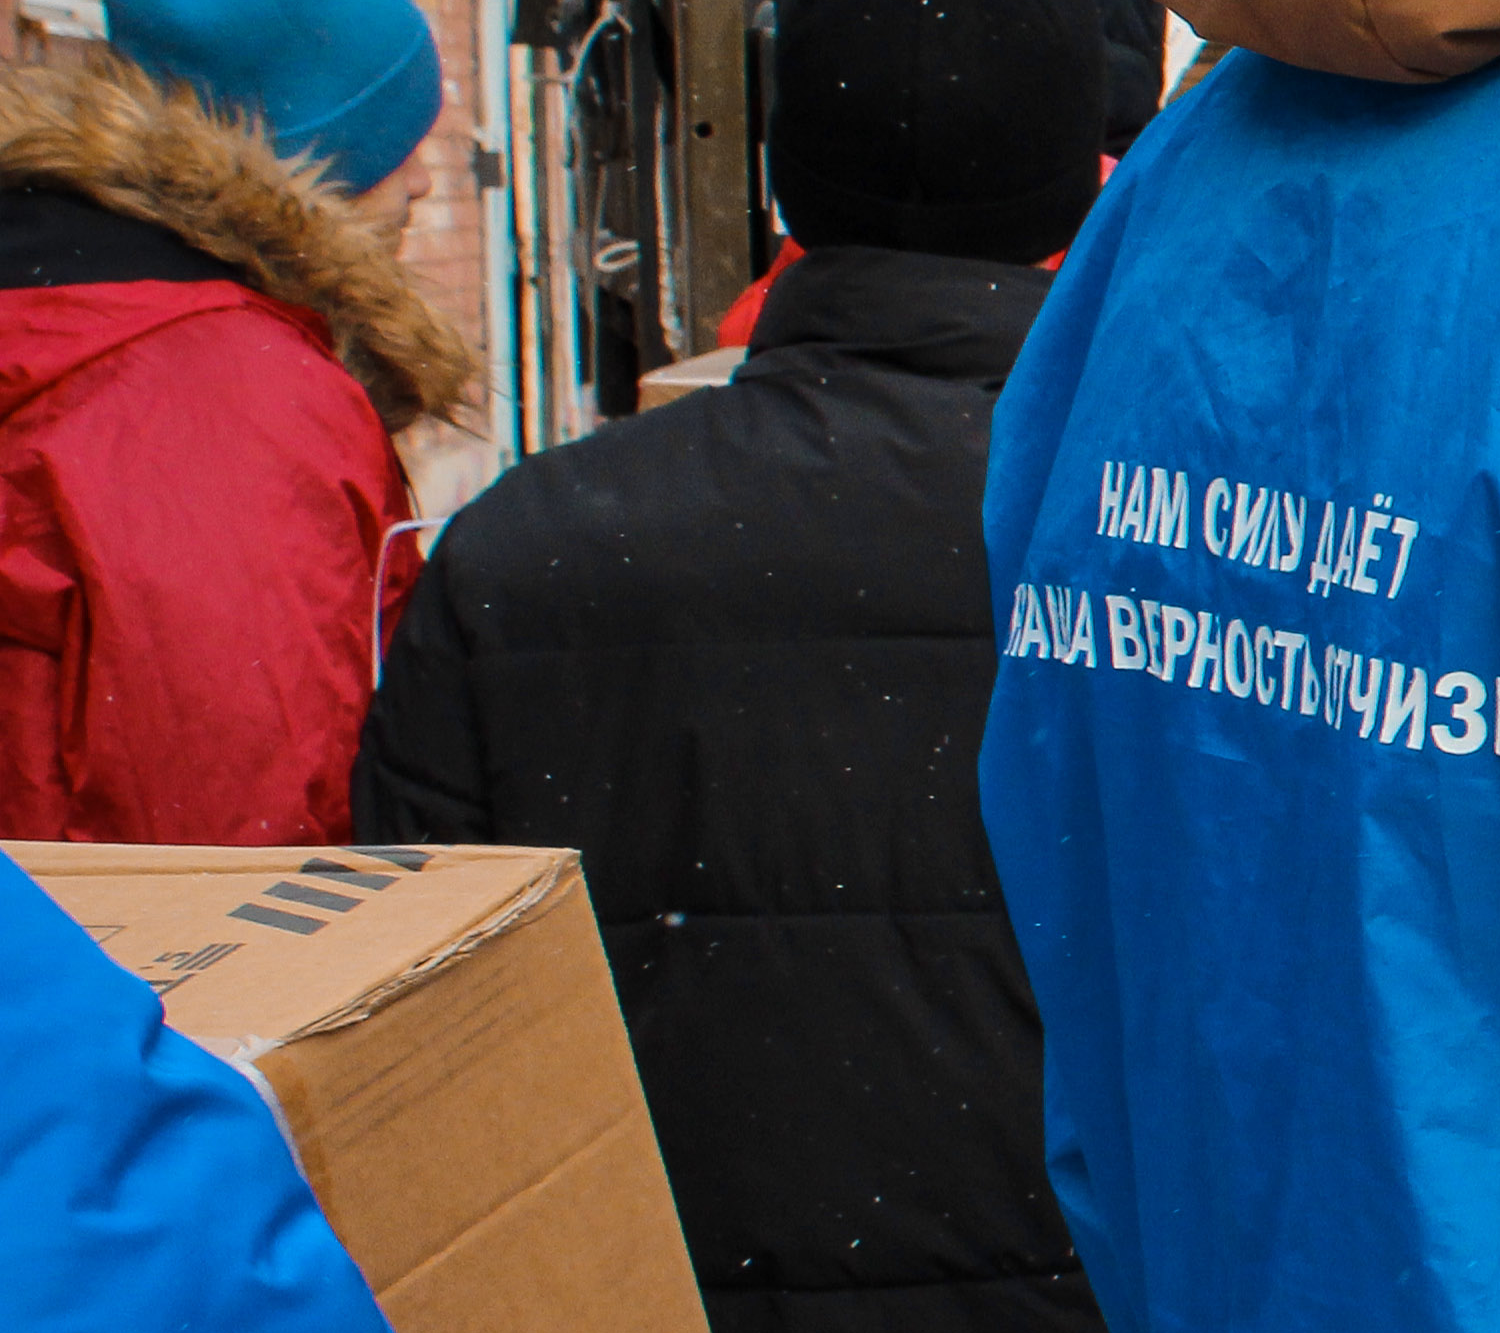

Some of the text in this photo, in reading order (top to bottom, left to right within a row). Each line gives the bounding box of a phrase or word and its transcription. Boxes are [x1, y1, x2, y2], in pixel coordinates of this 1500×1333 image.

[1096, 460, 1420, 600] НАМ СИЛУ ДАЁТ
[1104, 594, 1321, 717] ВЕРНОСТЬ
